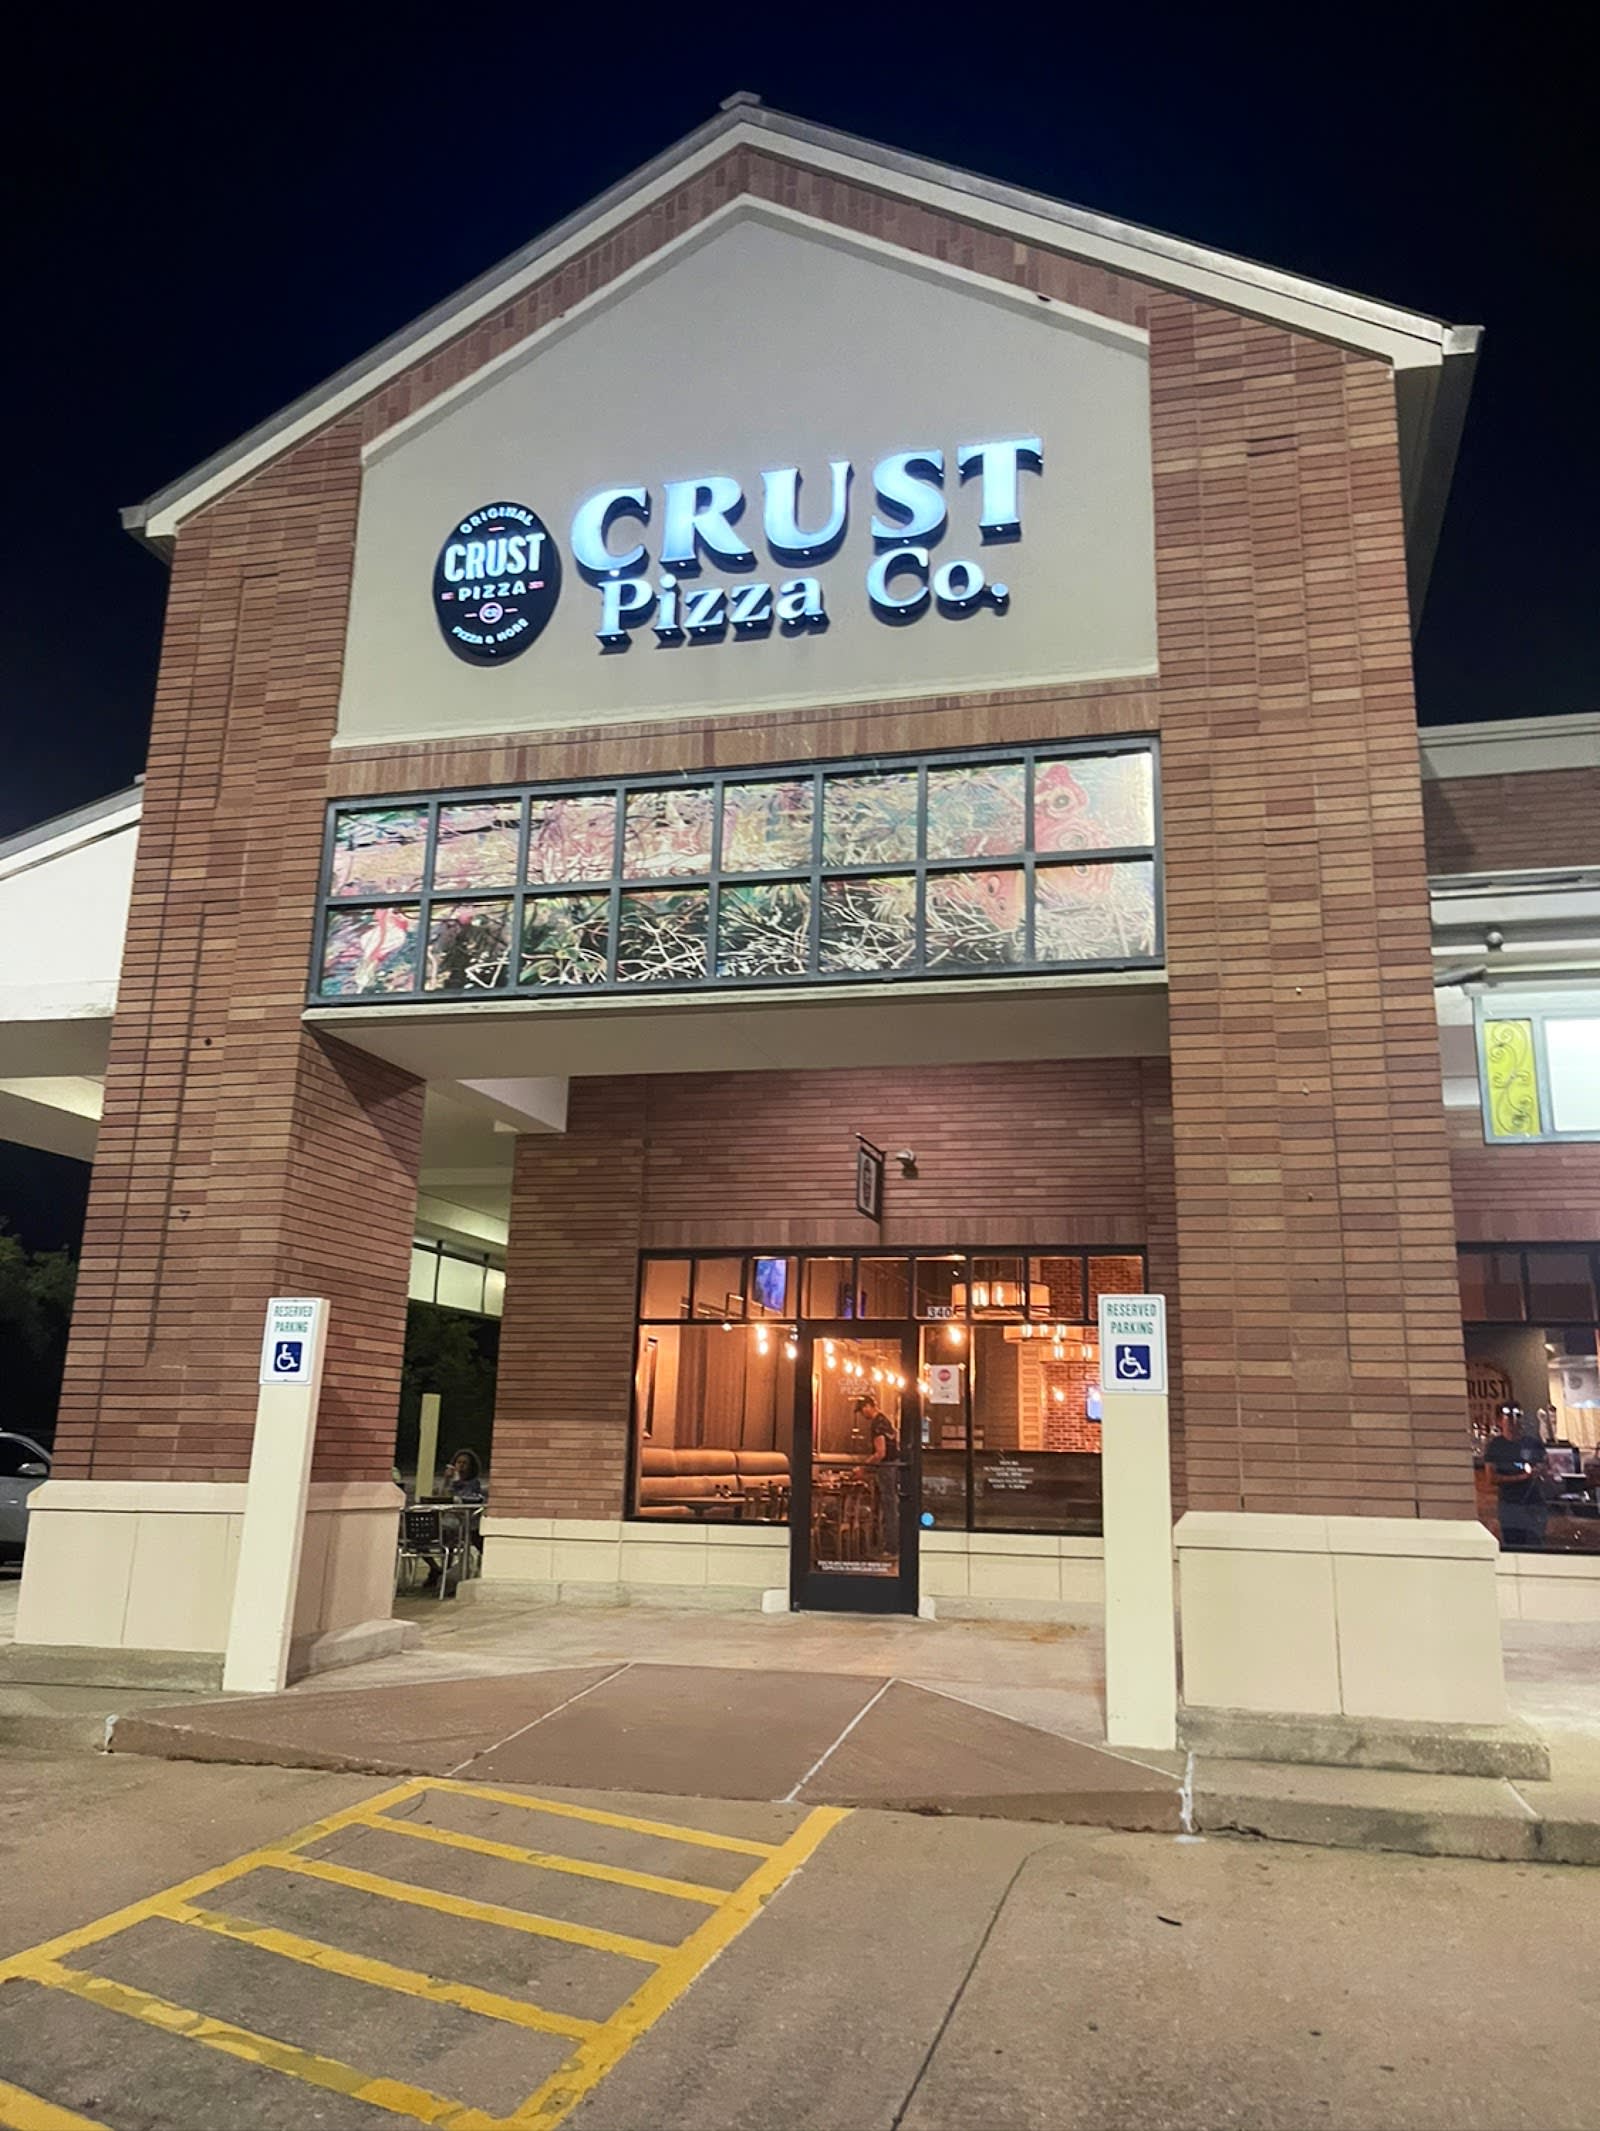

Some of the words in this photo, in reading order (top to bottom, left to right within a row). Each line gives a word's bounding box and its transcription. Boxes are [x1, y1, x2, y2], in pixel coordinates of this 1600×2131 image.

[571, 438, 1044, 580] CRUST
[459, 506, 534, 534] ORIGINAL
[444, 532, 547, 582] CRUST
[458, 580, 527, 602] PIZZA
[597, 574, 826, 645] Pizza
[866, 547, 1010, 620] Co.
[452, 625, 484, 645] PIZZA
[273, 1305, 313, 1318] RESERVED
[928, 1306, 952, 1319] 340
[1106, 1303, 1157, 1317] RESERVED
[274, 1321, 309, 1333] PARKING
[1110, 1321, 1154, 1335] PARKING
[1467, 1380, 1507, 1399] RUST
